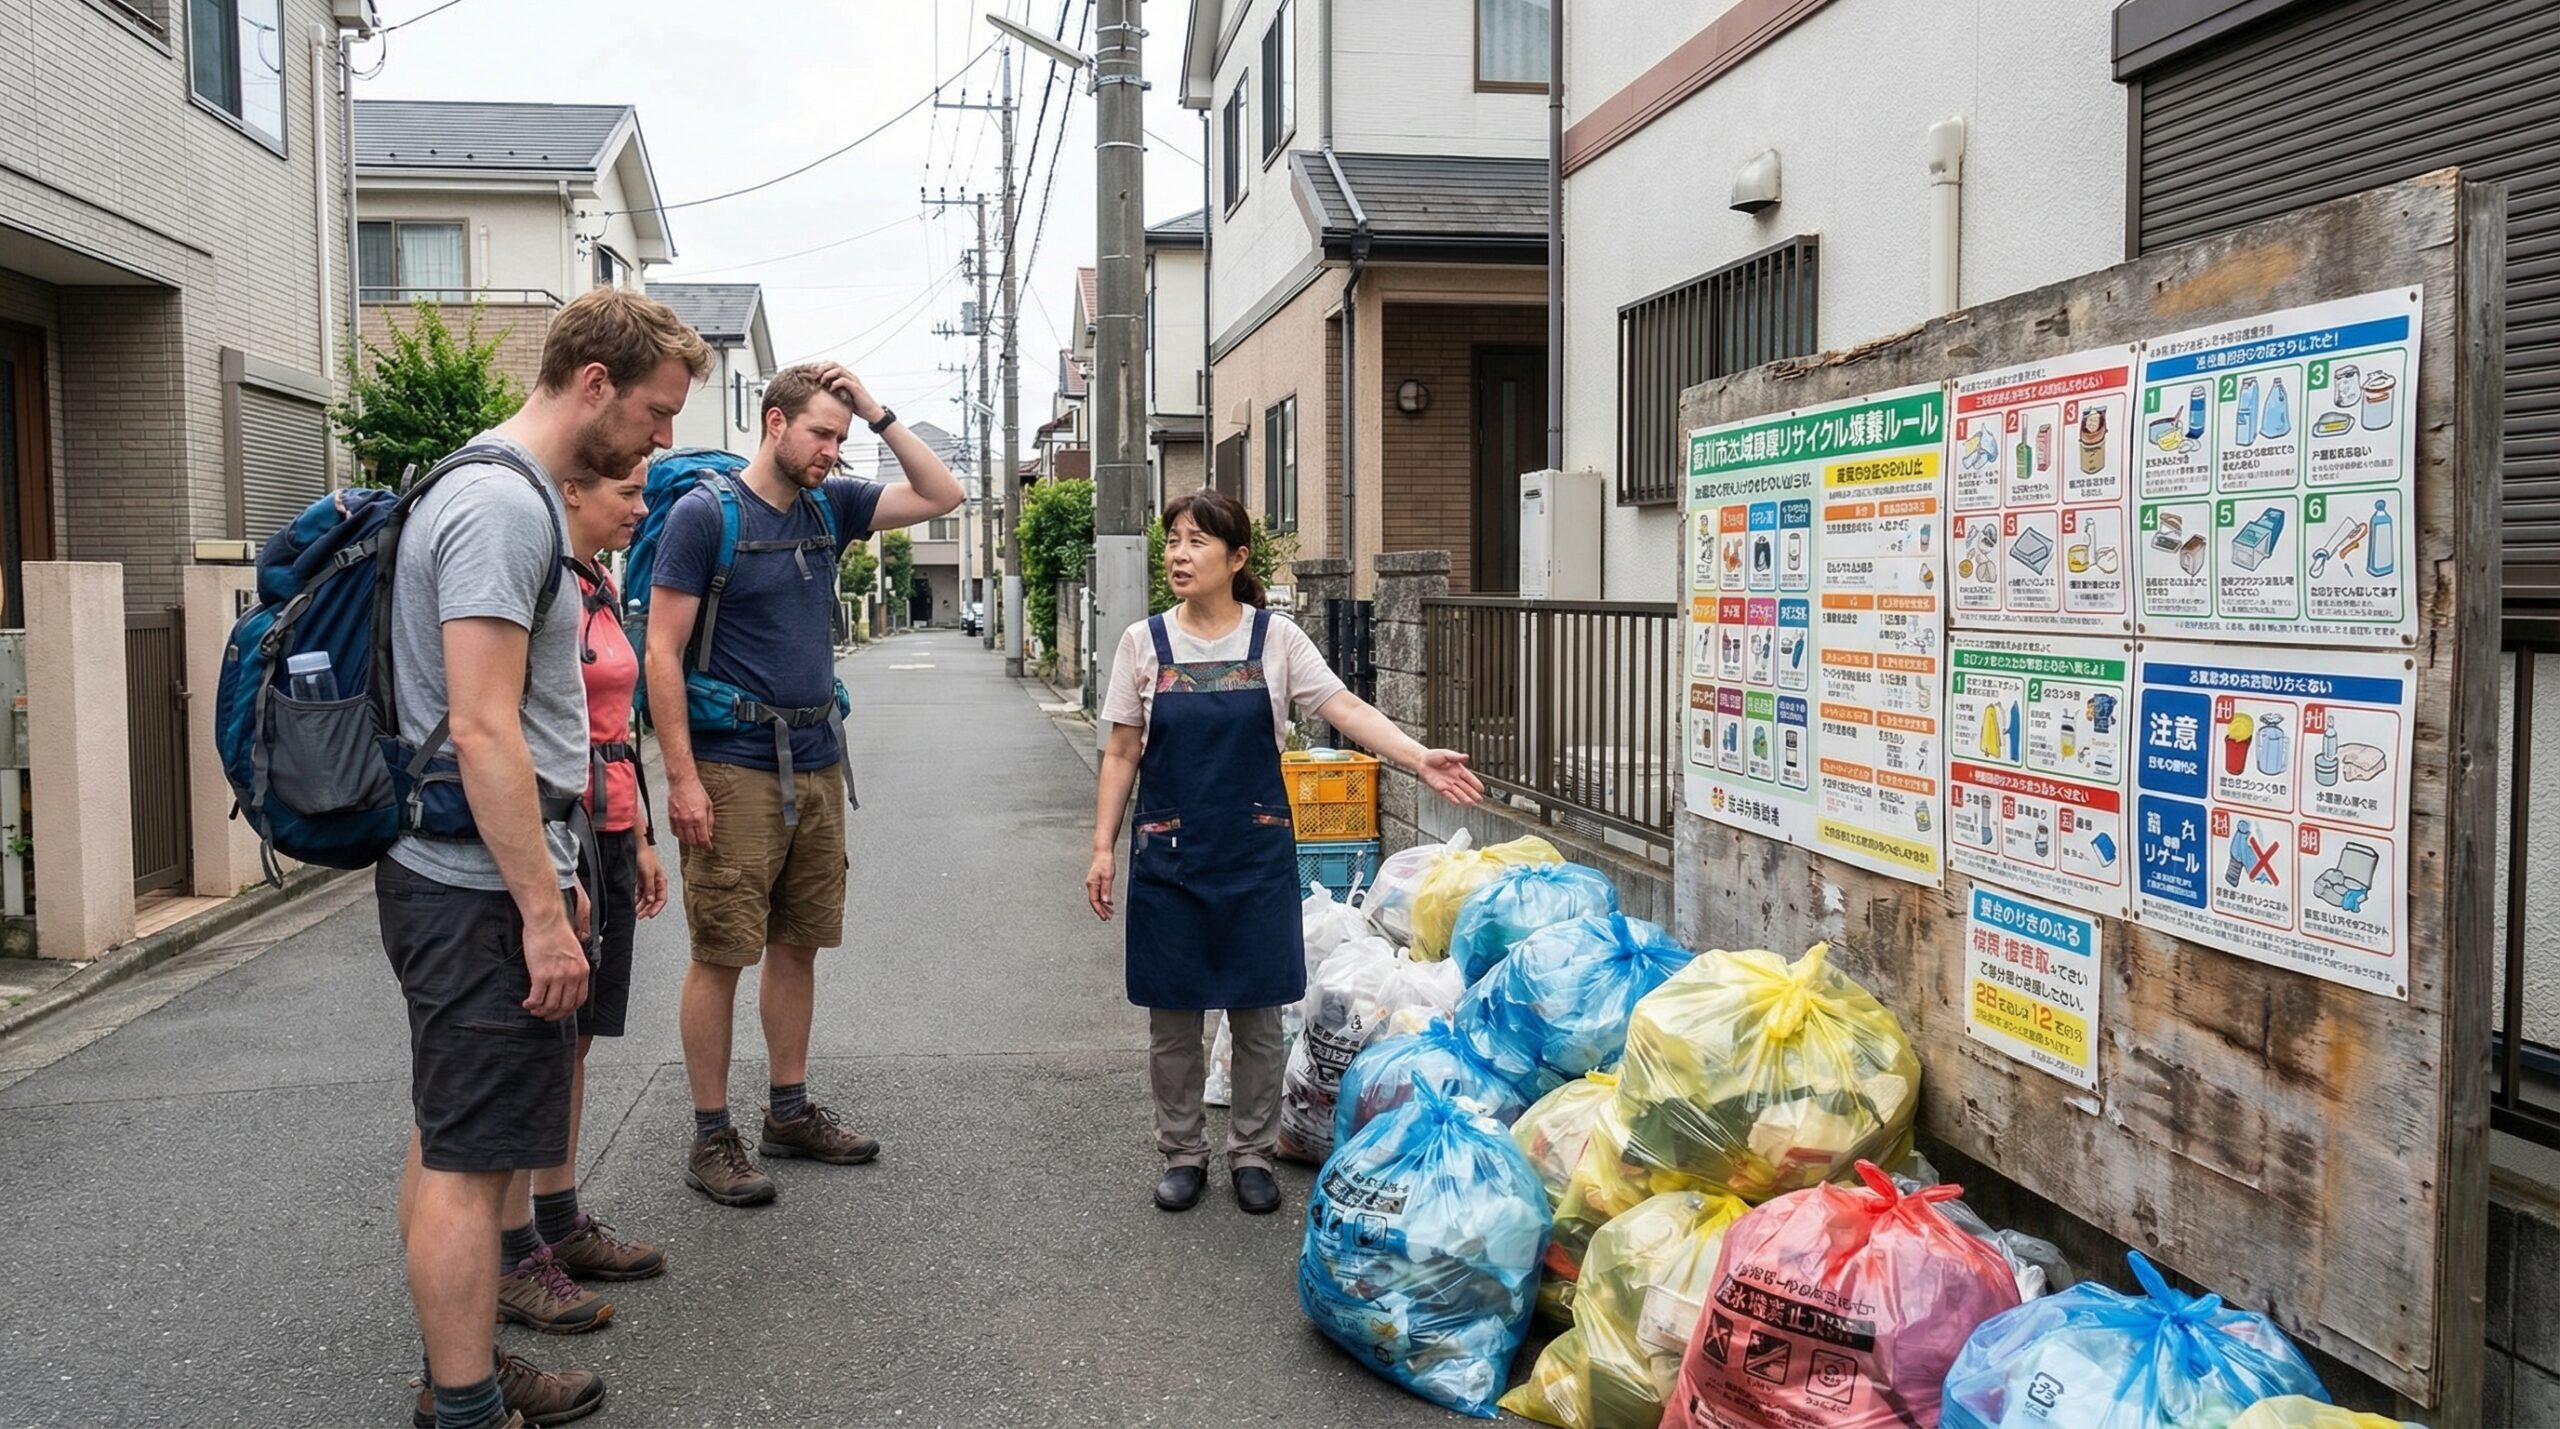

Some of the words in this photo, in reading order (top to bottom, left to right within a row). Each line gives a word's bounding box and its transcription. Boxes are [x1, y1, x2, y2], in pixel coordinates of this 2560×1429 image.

[2311, 364, 2325, 386] 3
[2221, 378, 2234, 398] 2
[2147, 390, 2156, 410] 1
[2007, 412, 2017, 431] 2
[2066, 402, 2077, 422] 3
[1958, 420, 1965, 438] 1
[2142, 508, 2155, 528] 4
[2219, 503, 2233, 524] 5
[2309, 498, 2322, 519] 6
[1954, 520, 1964, 536] 4
[2063, 513, 2075, 532] 5
[1955, 674, 1962, 691] 1
[2029, 683, 2040, 700] 2
[2149, 710, 2199, 752] 注意
[2032, 1003, 2054, 1032] 12
